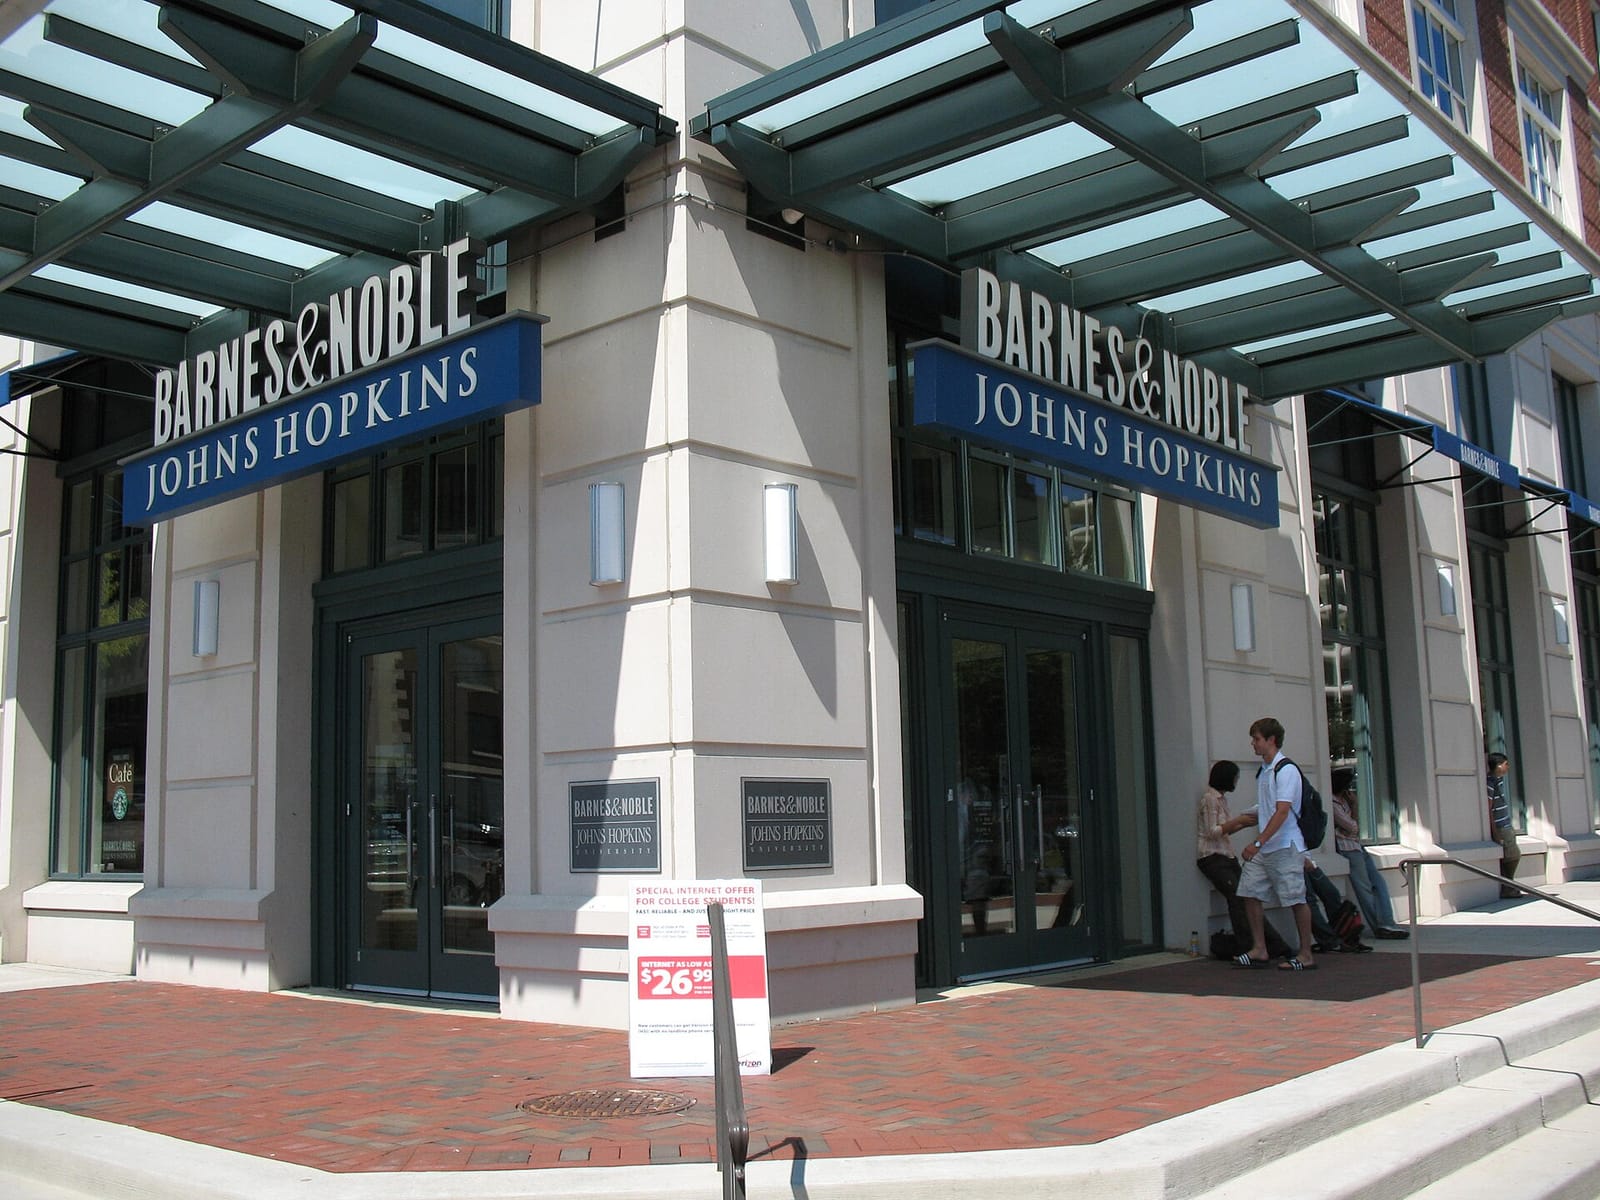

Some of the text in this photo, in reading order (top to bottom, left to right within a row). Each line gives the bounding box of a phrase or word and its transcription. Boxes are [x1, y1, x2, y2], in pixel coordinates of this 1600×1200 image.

[154, 237, 471, 447] BARNES&NOBLE
[977, 268, 1252, 455] BARNES&NOBLE
[146, 347, 477, 511] JOHNS HOPKINS
[975, 373, 1261, 506] JOHNS HOPKINS
[109, 762, 133, 783] Café
[574, 797, 654, 817] BARNES&NOBLE
[747, 795, 825, 814] BARNES&NOBLE
[575, 827, 652, 848] JOHNS HOPKINS
[749, 825, 824, 845] JOHNS HOPKINS
[636, 887, 674, 895] SPECIAL
[725, 886, 755, 894] OFFER
[738, 1060, 762, 1068] rizon
